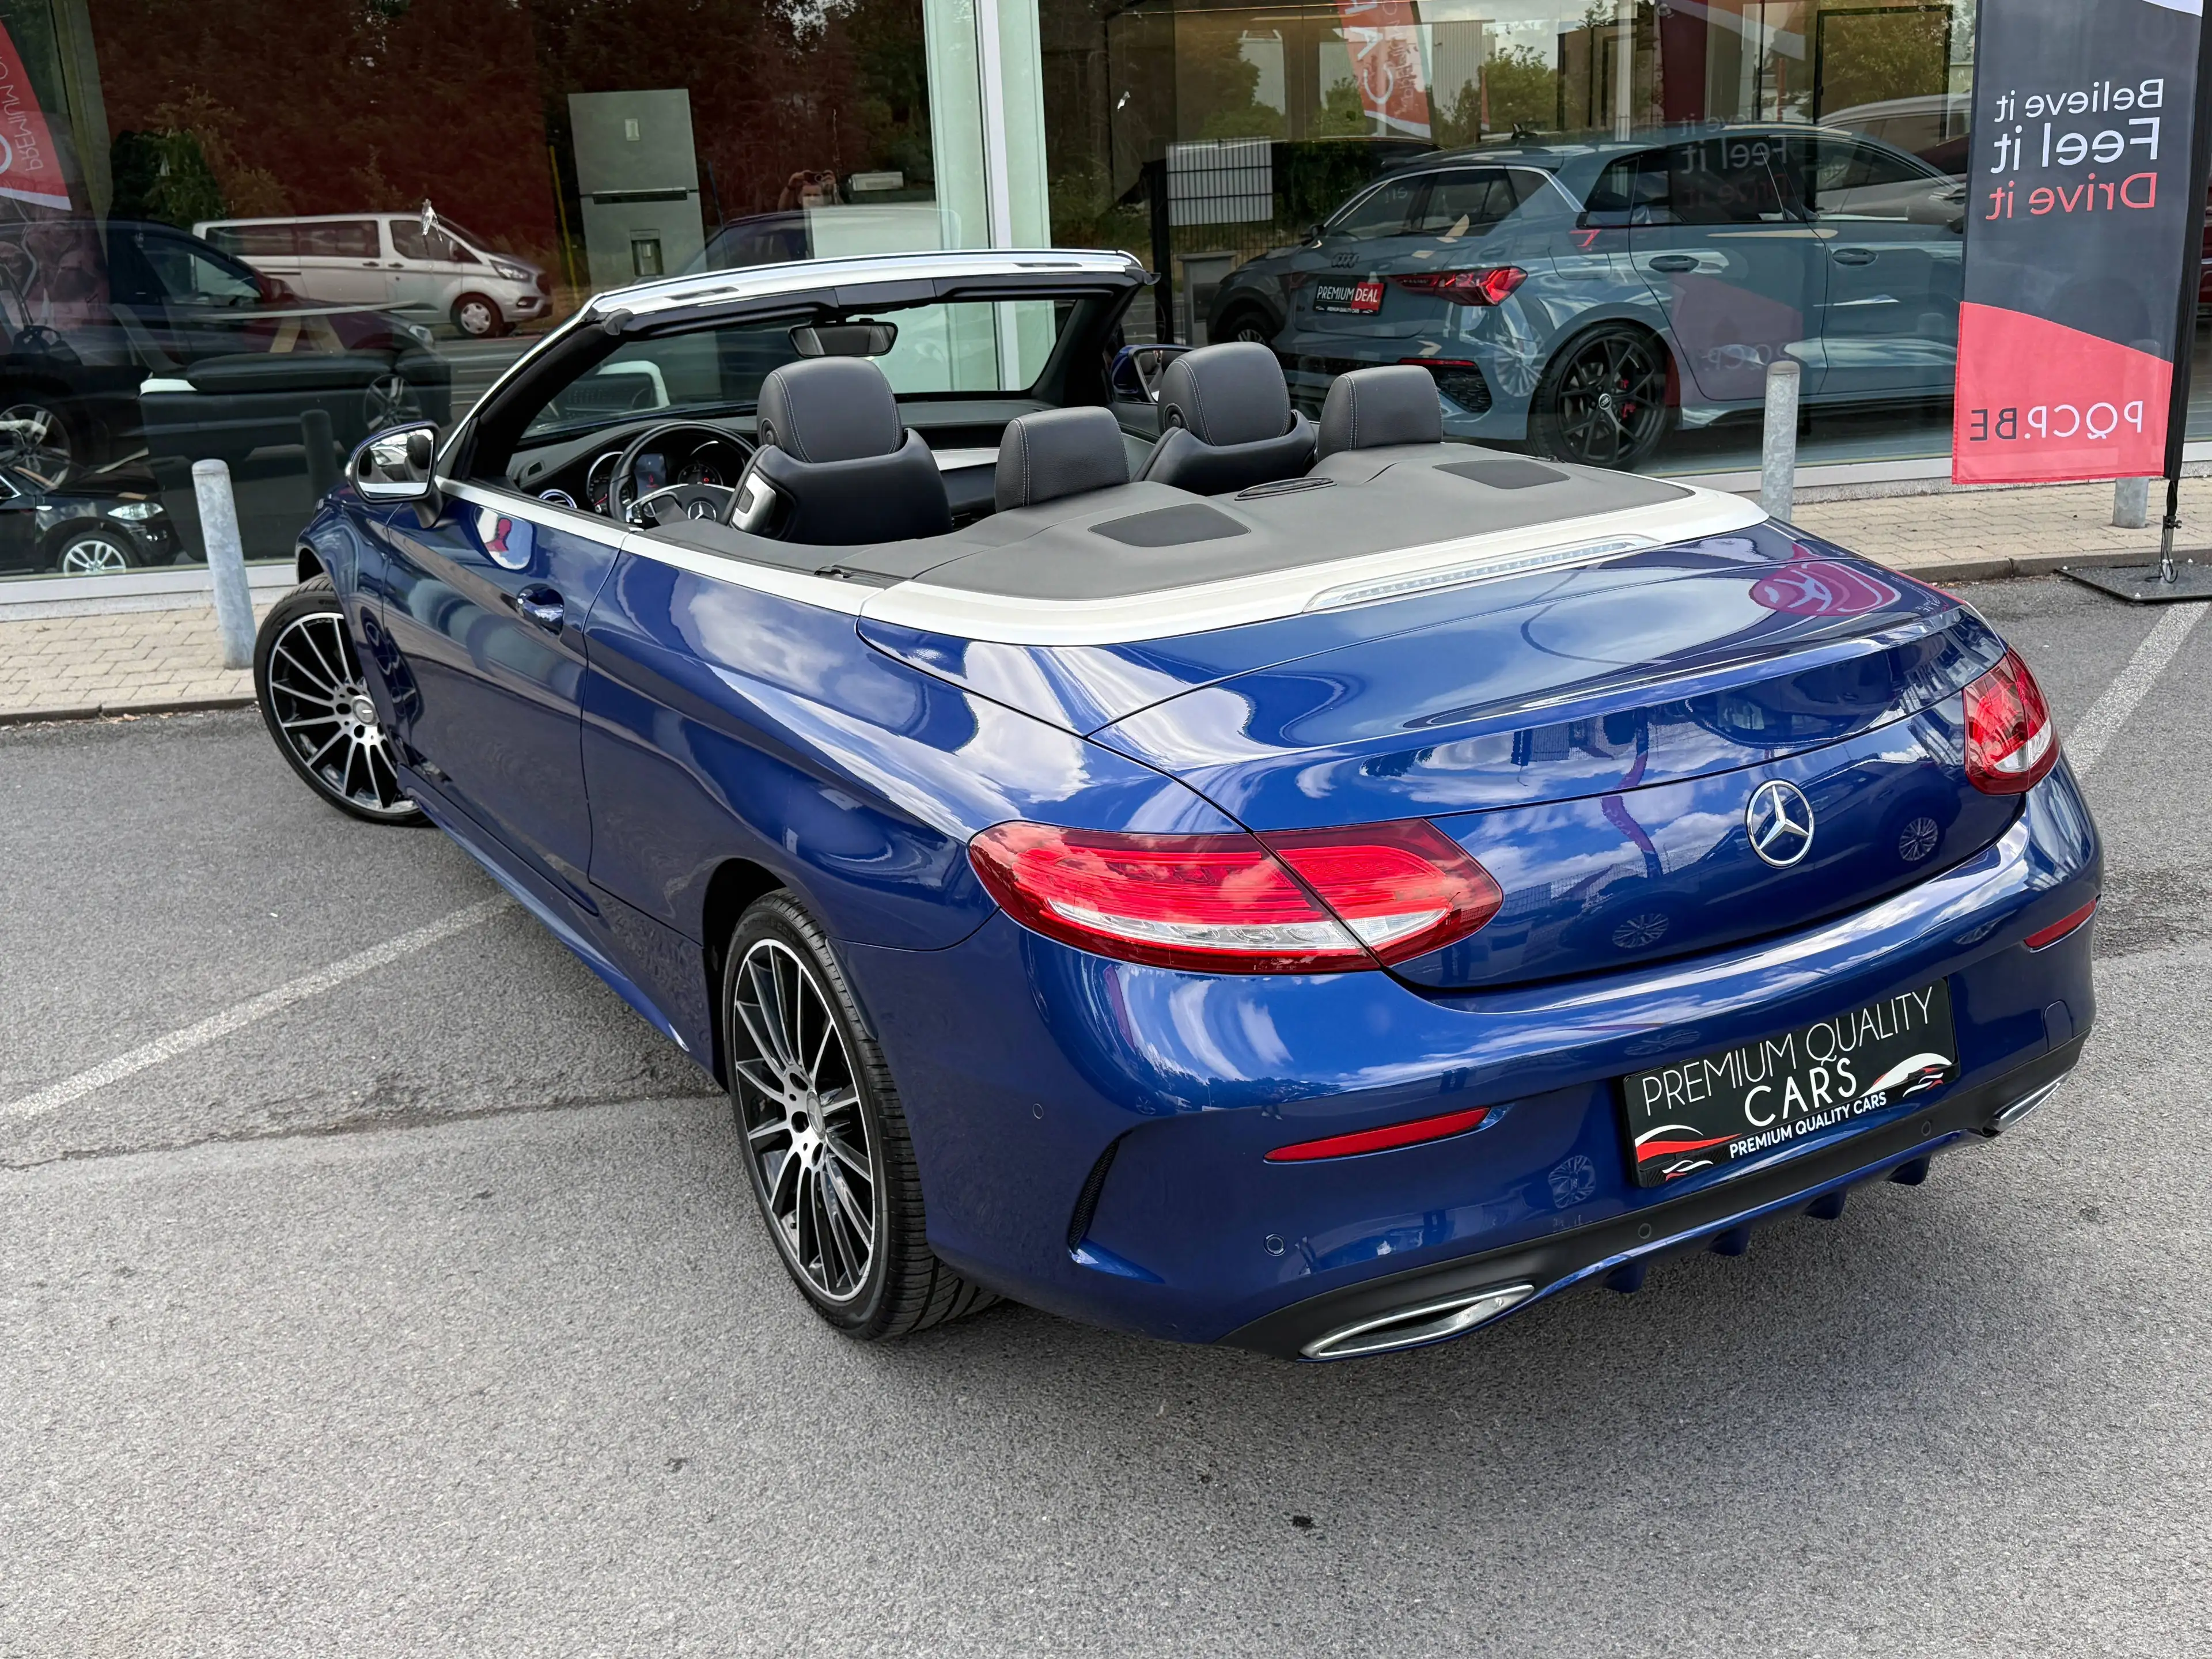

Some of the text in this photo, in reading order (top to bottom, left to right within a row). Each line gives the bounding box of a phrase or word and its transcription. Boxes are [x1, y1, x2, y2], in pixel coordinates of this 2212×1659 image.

[1316, 286, 1378, 302] PREMIUM DEAL
[1642, 986, 1933, 1116] PREMIUM QUALITY
[1729, 1091, 1887, 1158] PREMIUM QUALITY CARS
[1744, 1058, 1857, 1127] CARS
